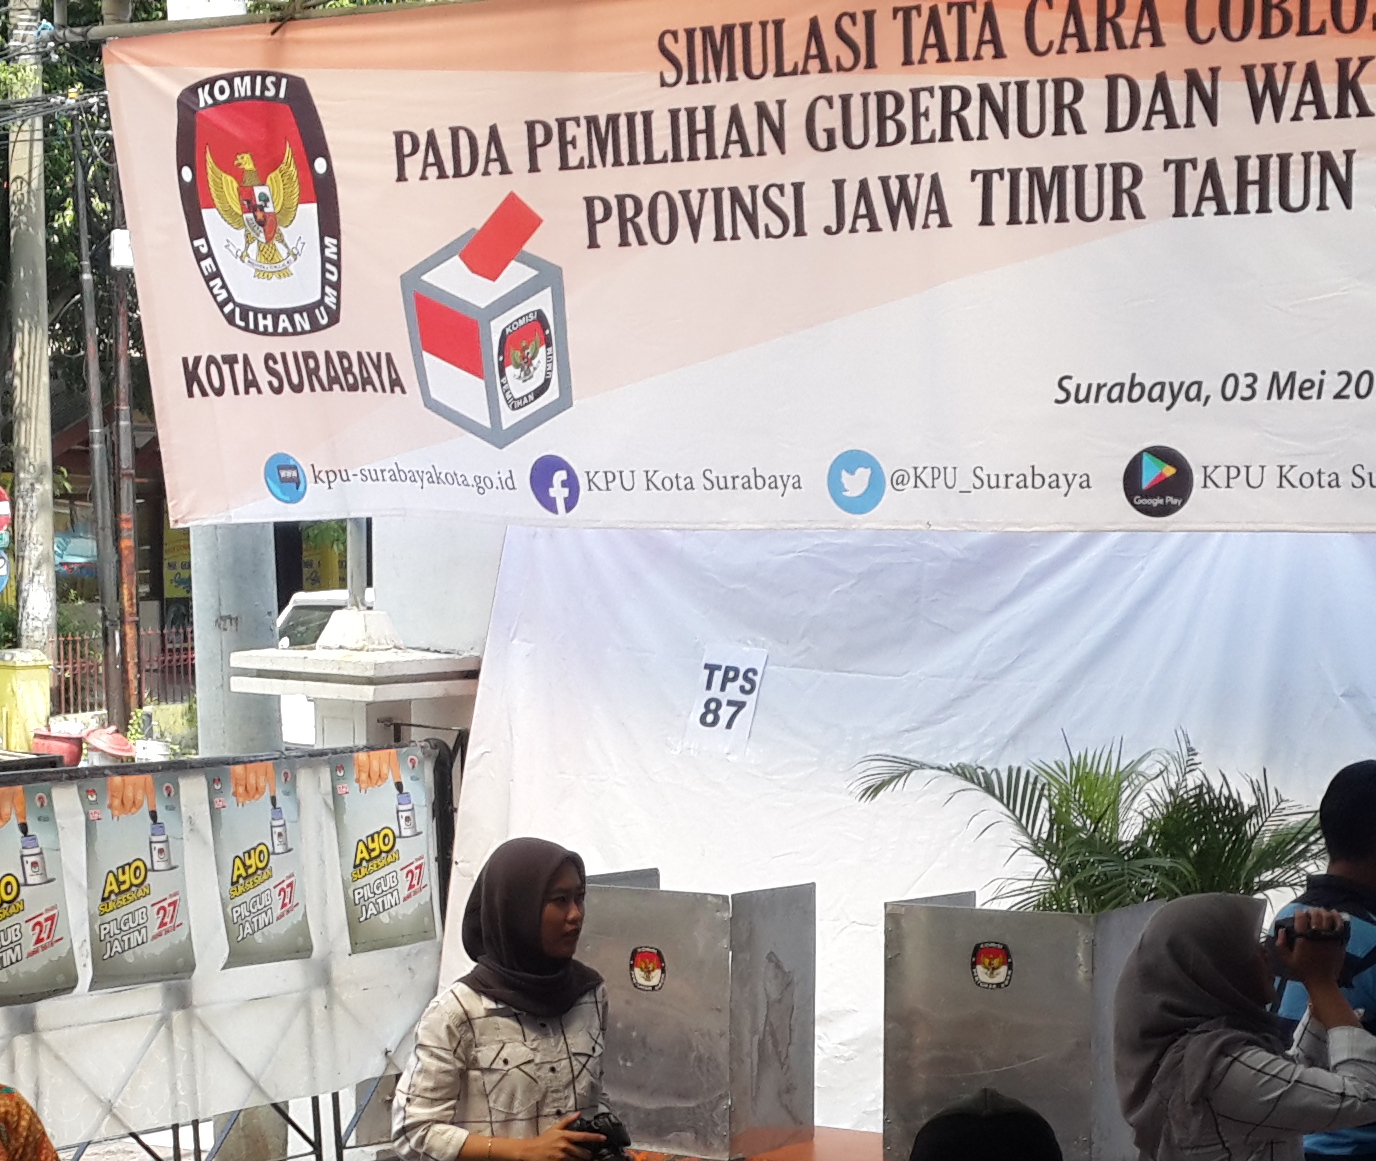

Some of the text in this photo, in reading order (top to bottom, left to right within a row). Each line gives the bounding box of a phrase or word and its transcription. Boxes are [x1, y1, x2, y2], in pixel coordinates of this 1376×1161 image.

[658, 9, 878, 88] SIMULASI
[893, 0, 1007, 66] TATA
[1024, 0, 1165, 56] CARA
[197, 75, 288, 107] KOMISI
[393, 123, 512, 184] PADA
[525, 98, 787, 174] PEMILIHAN
[804, 78, 1087, 153] GUBERNUR
[1104, 65, 1222, 134] DAN
[585, 179, 807, 250] PROVINSI
[823, 171, 953, 238] JAWA
[970, 161, 1147, 227] TIMUR
[1162, 148, 1356, 219] TAHUN
[193, 236, 338, 333] PEMILIHAN UMUM
[506, 311, 537, 335] KOMISI
[182, 350, 407, 398] KOTA SURABAYA
[1054, 373, 1212, 413] Surabaya,
[1221, 371, 1258, 402] 03
[1267, 369, 1328, 402] Mei
[311, 462, 518, 494] kpu-surabayakota.go.id
[585, 465, 803, 494] KPU Kota Surabaya
[890, 464, 1093, 498] @KPU_Surabaya
[1200, 465, 1267, 491] KPU
[1275, 464, 1342, 491] Kota
[1133, 495, 1164, 507] Google
[704, 663, 758, 695] TPS
[699, 697, 747, 730] 87
[230, 842, 271, 886] AYO
[353, 826, 397, 869] AYO
[101, 858, 148, 902] AYO
[354, 870, 398, 906] PILGUB
[404, 861, 426, 893] 27
[277, 879, 296, 912] 27
[358, 889, 400, 923] JATIM
[31, 911, 59, 948] 27
[99, 906, 148, 942] PILGUB
[155, 896, 180, 931] 27
[102, 926, 148, 960] JATIM
